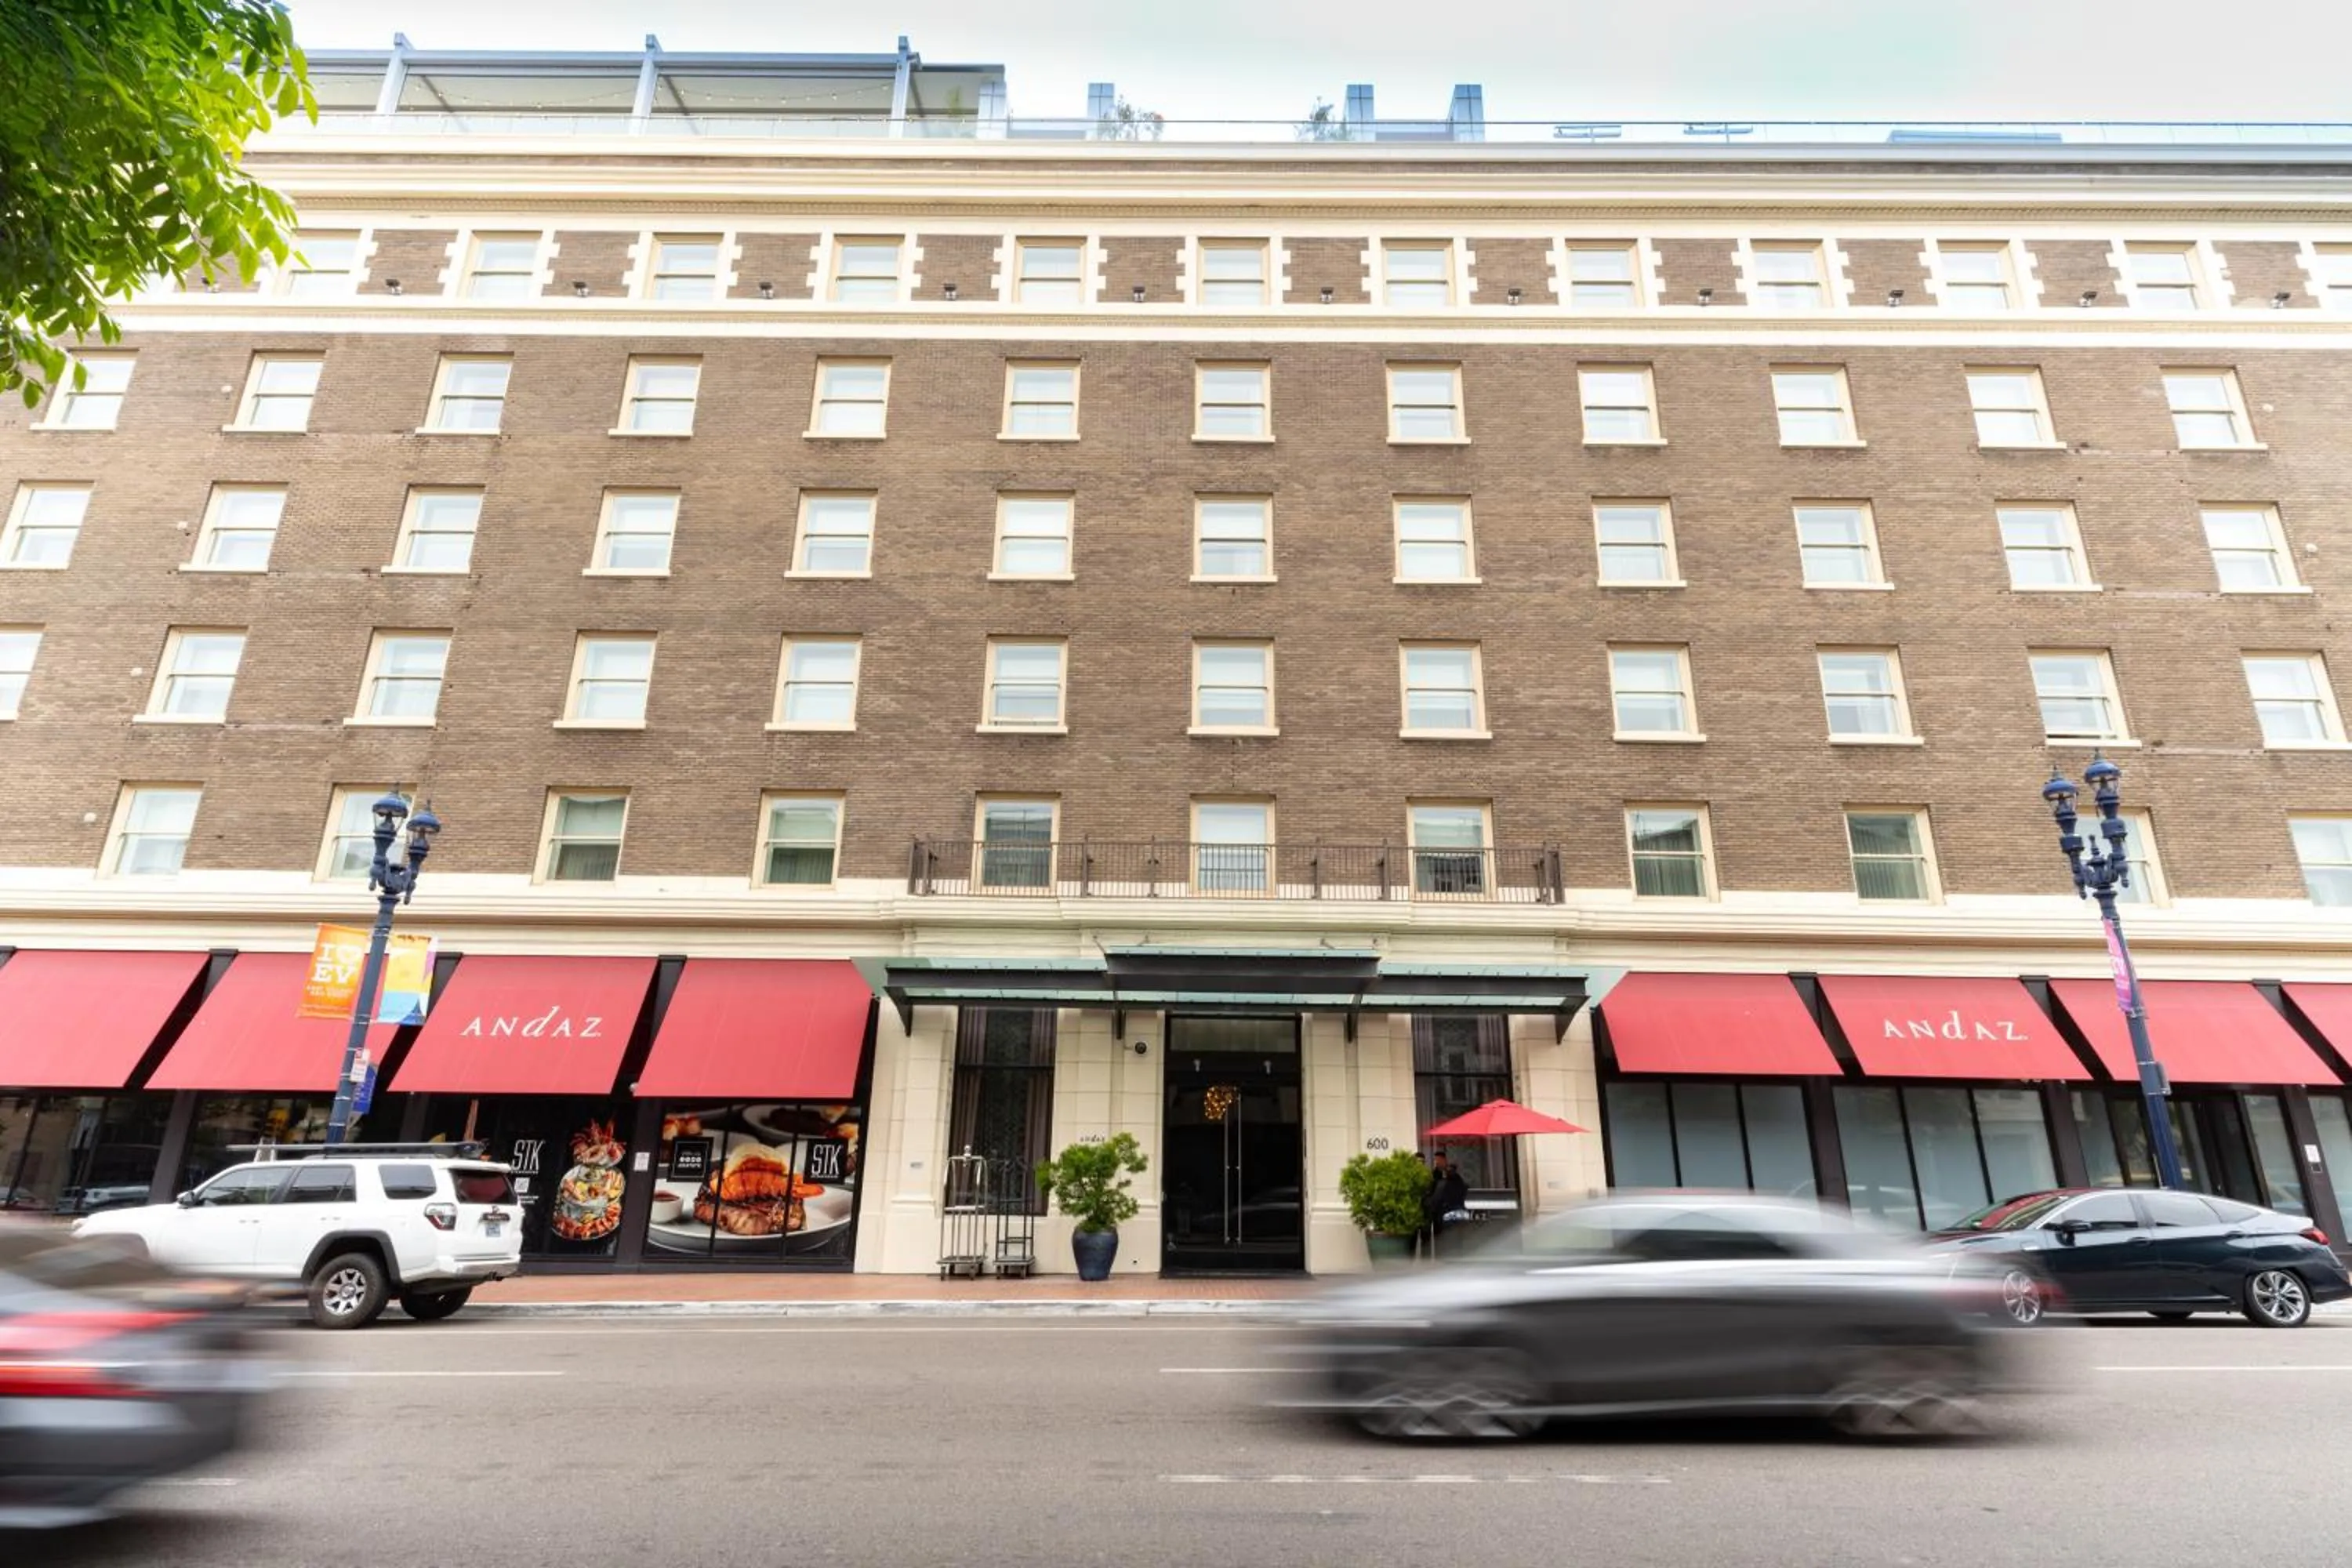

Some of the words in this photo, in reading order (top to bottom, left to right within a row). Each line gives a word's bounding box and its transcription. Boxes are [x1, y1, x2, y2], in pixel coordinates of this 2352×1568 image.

[311, 963, 358, 983] EV
[511, 1139, 544, 1171] STK
[1367, 1137, 1388, 1150] 600
[811, 1144, 841, 1174] STK
